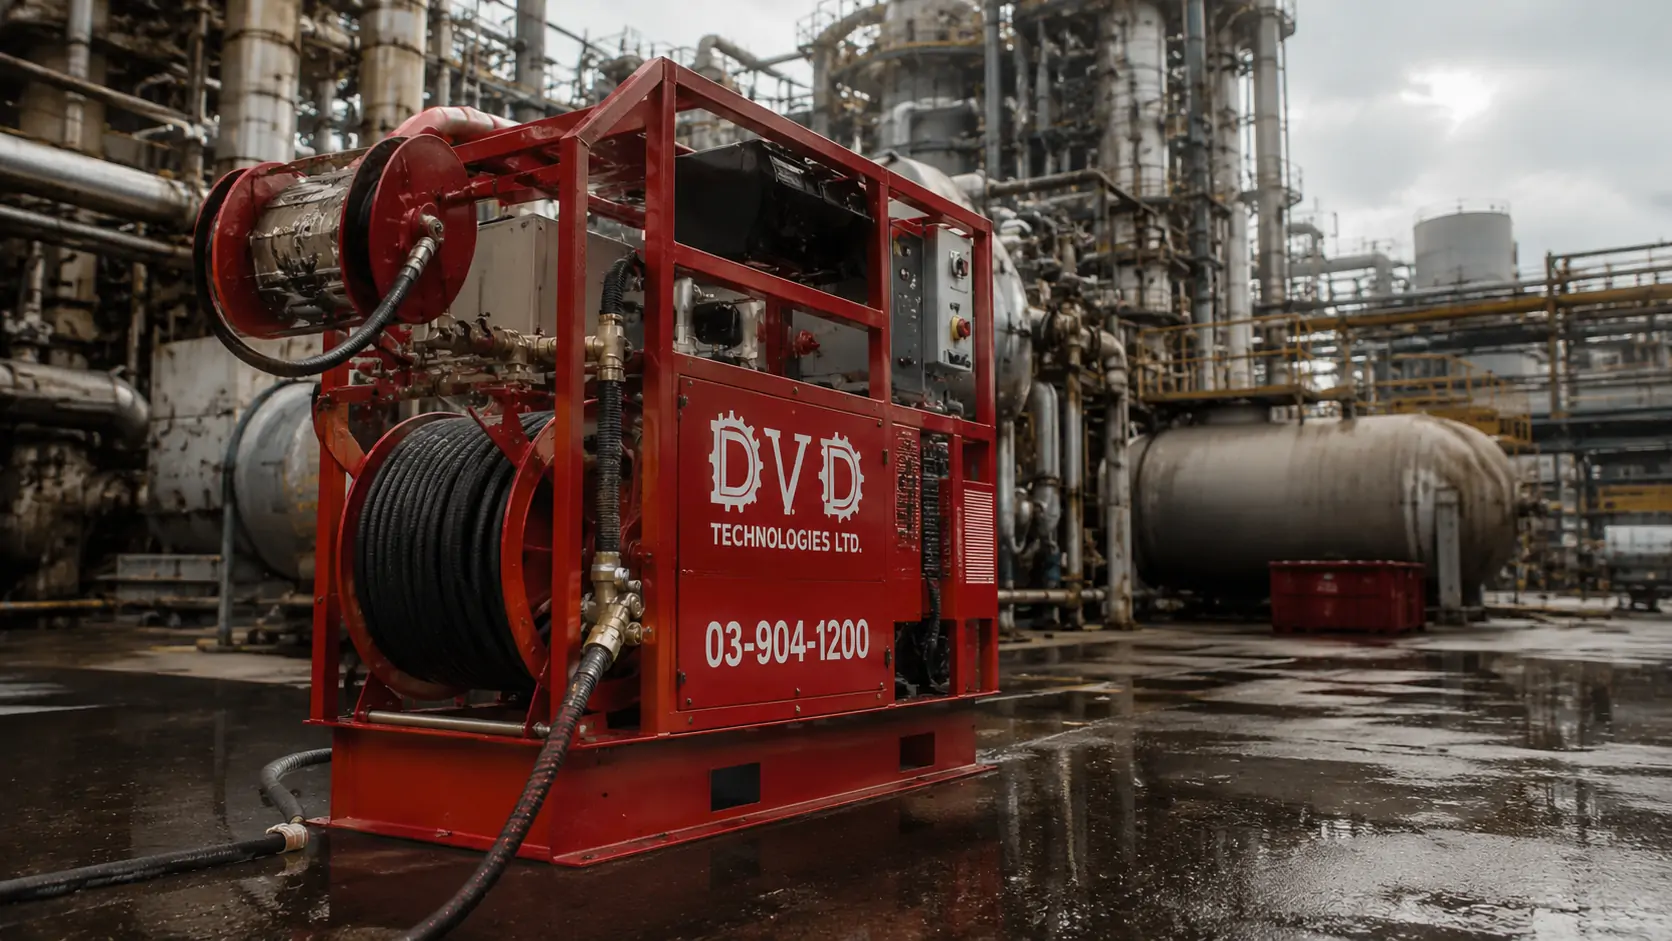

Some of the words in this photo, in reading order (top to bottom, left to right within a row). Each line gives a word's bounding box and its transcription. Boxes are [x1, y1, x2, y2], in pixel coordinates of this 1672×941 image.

[710, 522, 830, 552] TECHNOLOGIES
[835, 531, 863, 553] LTD.
[705, 619, 870, 668] 03-904-1200
